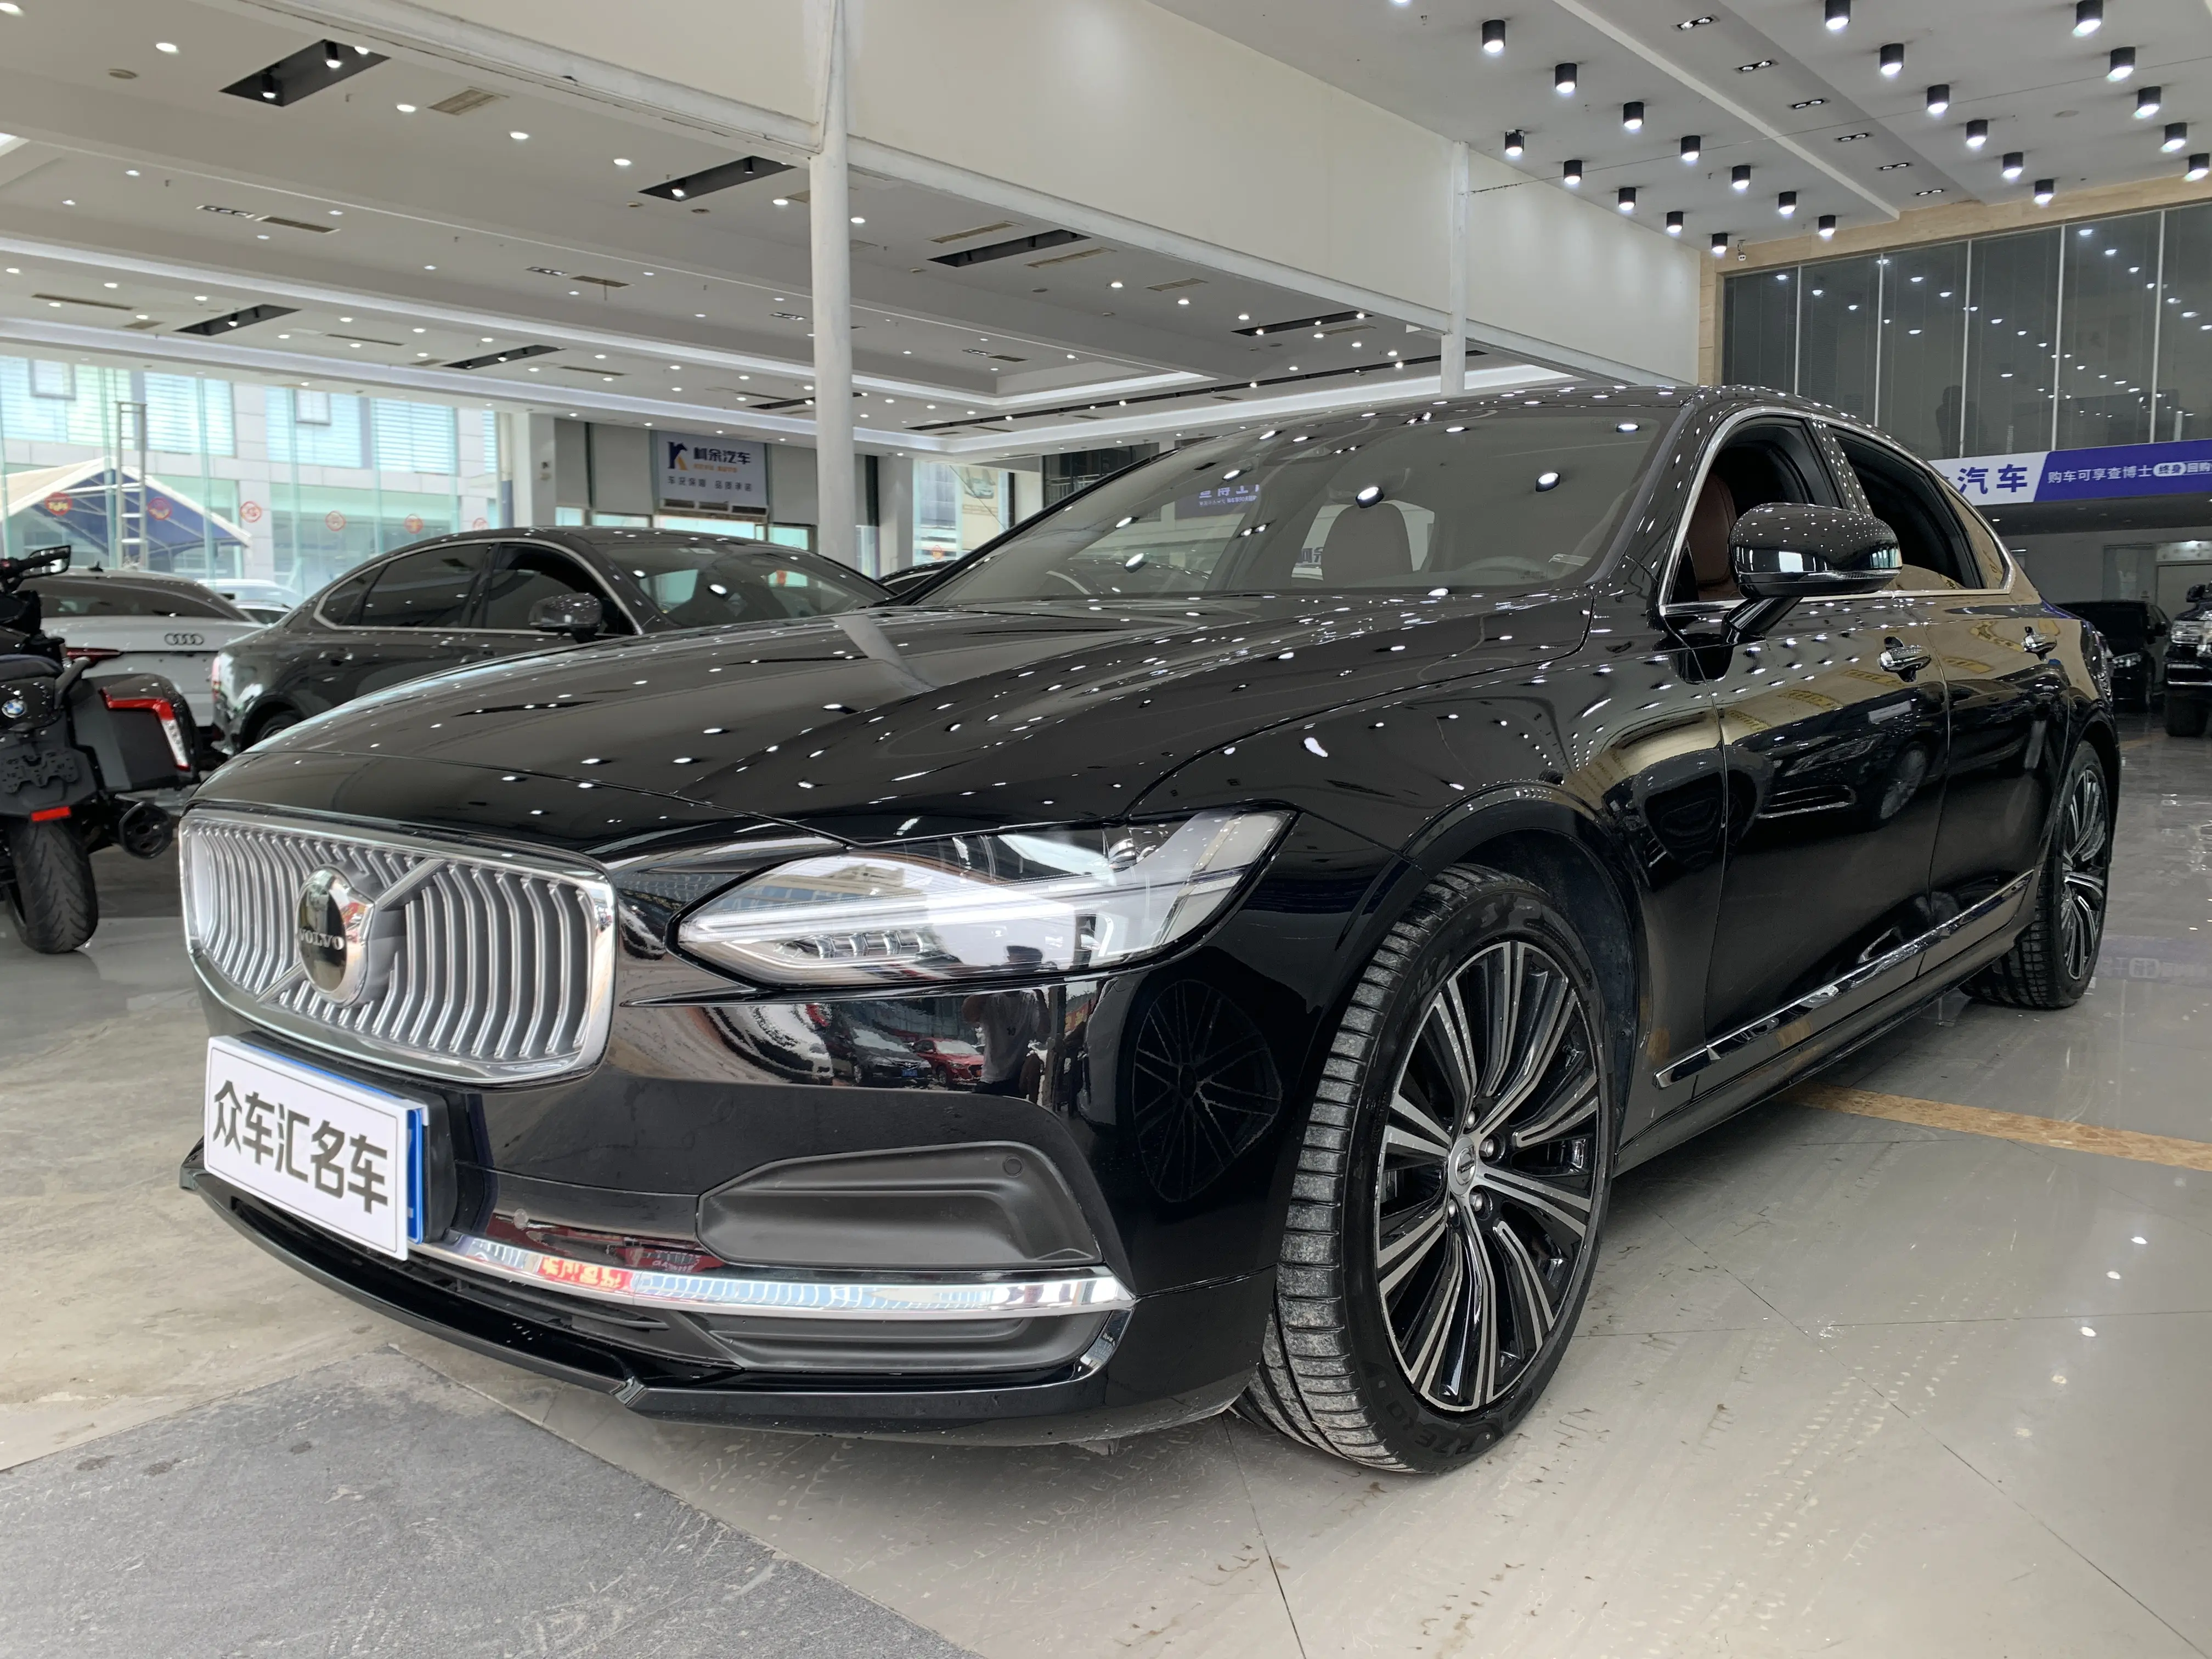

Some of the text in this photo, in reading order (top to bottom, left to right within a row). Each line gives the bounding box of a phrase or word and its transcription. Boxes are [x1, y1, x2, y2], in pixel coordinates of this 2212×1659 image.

[1944, 464, 2028, 495] 汽车
[300, 928, 345, 950] VOLVO
[213, 1080, 388, 1214] 众车汇名车
